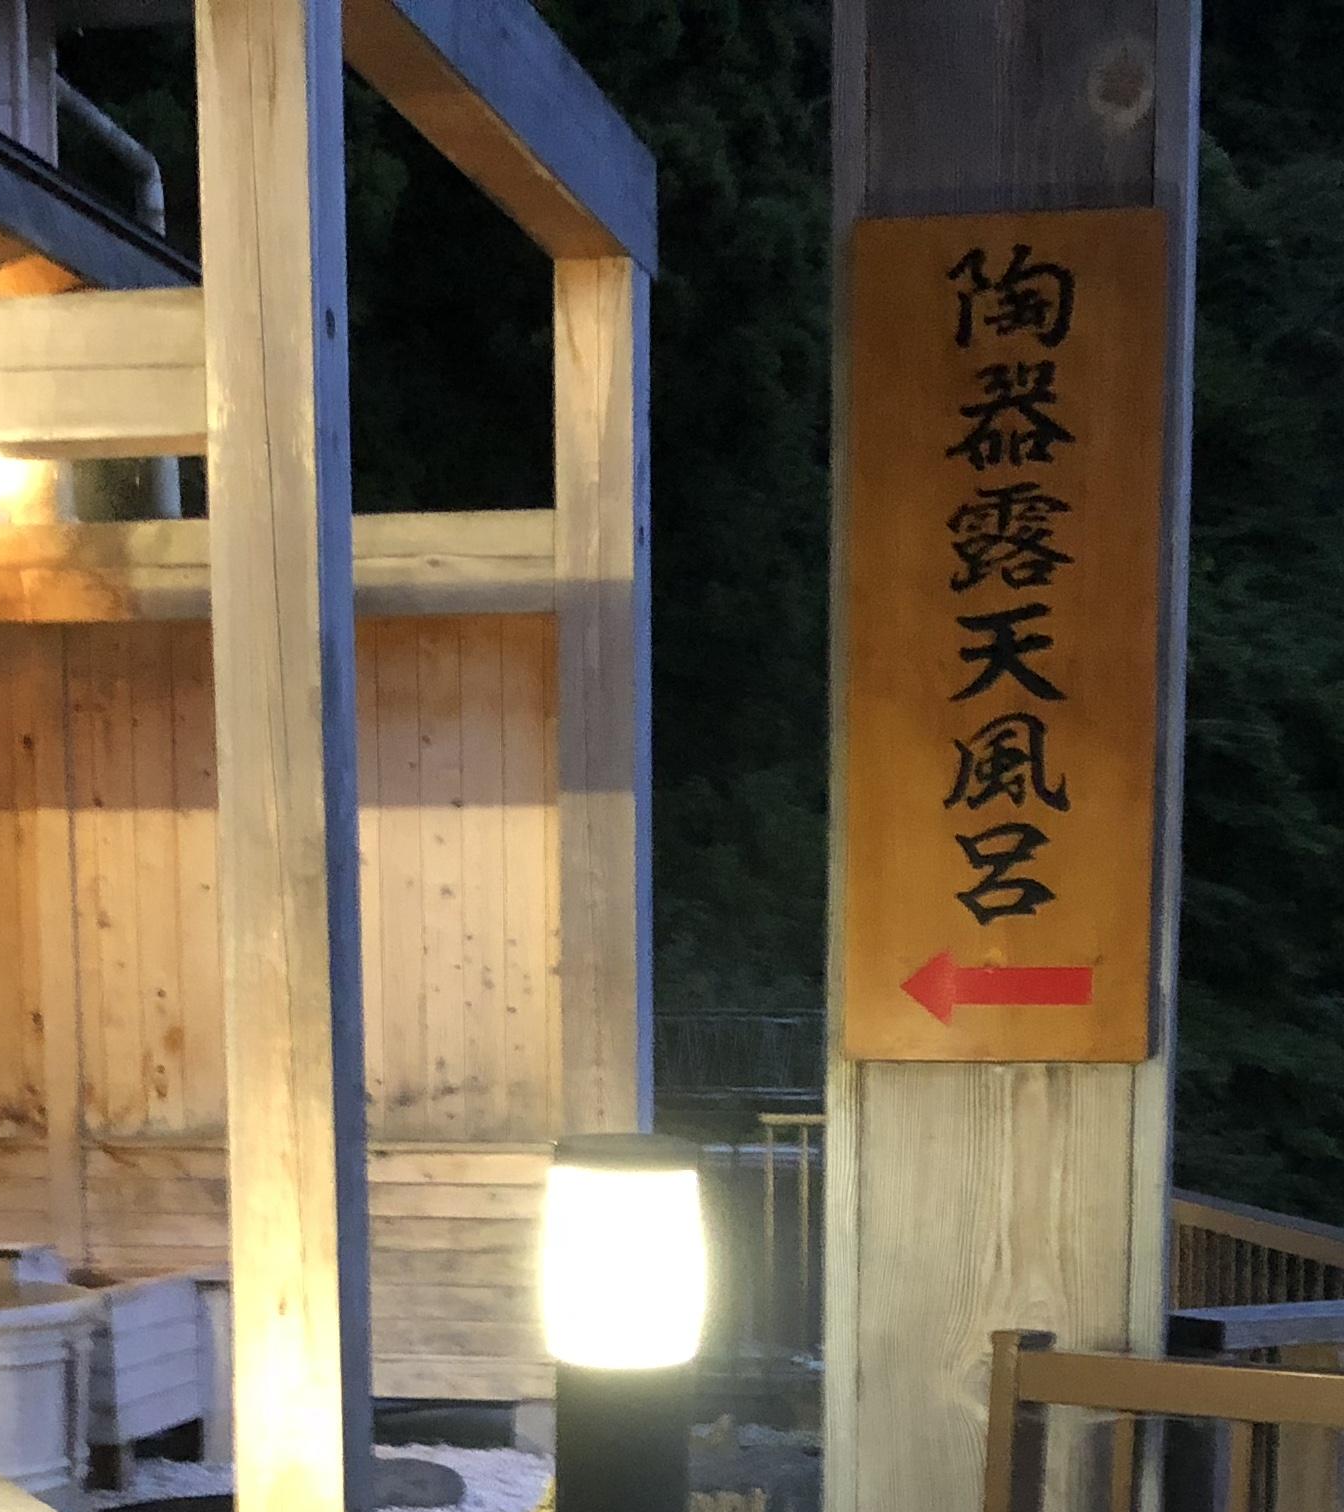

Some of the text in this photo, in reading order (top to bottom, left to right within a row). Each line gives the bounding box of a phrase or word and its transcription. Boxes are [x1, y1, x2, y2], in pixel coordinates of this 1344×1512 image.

[944, 243, 1077, 925] 陶器露天風呂
